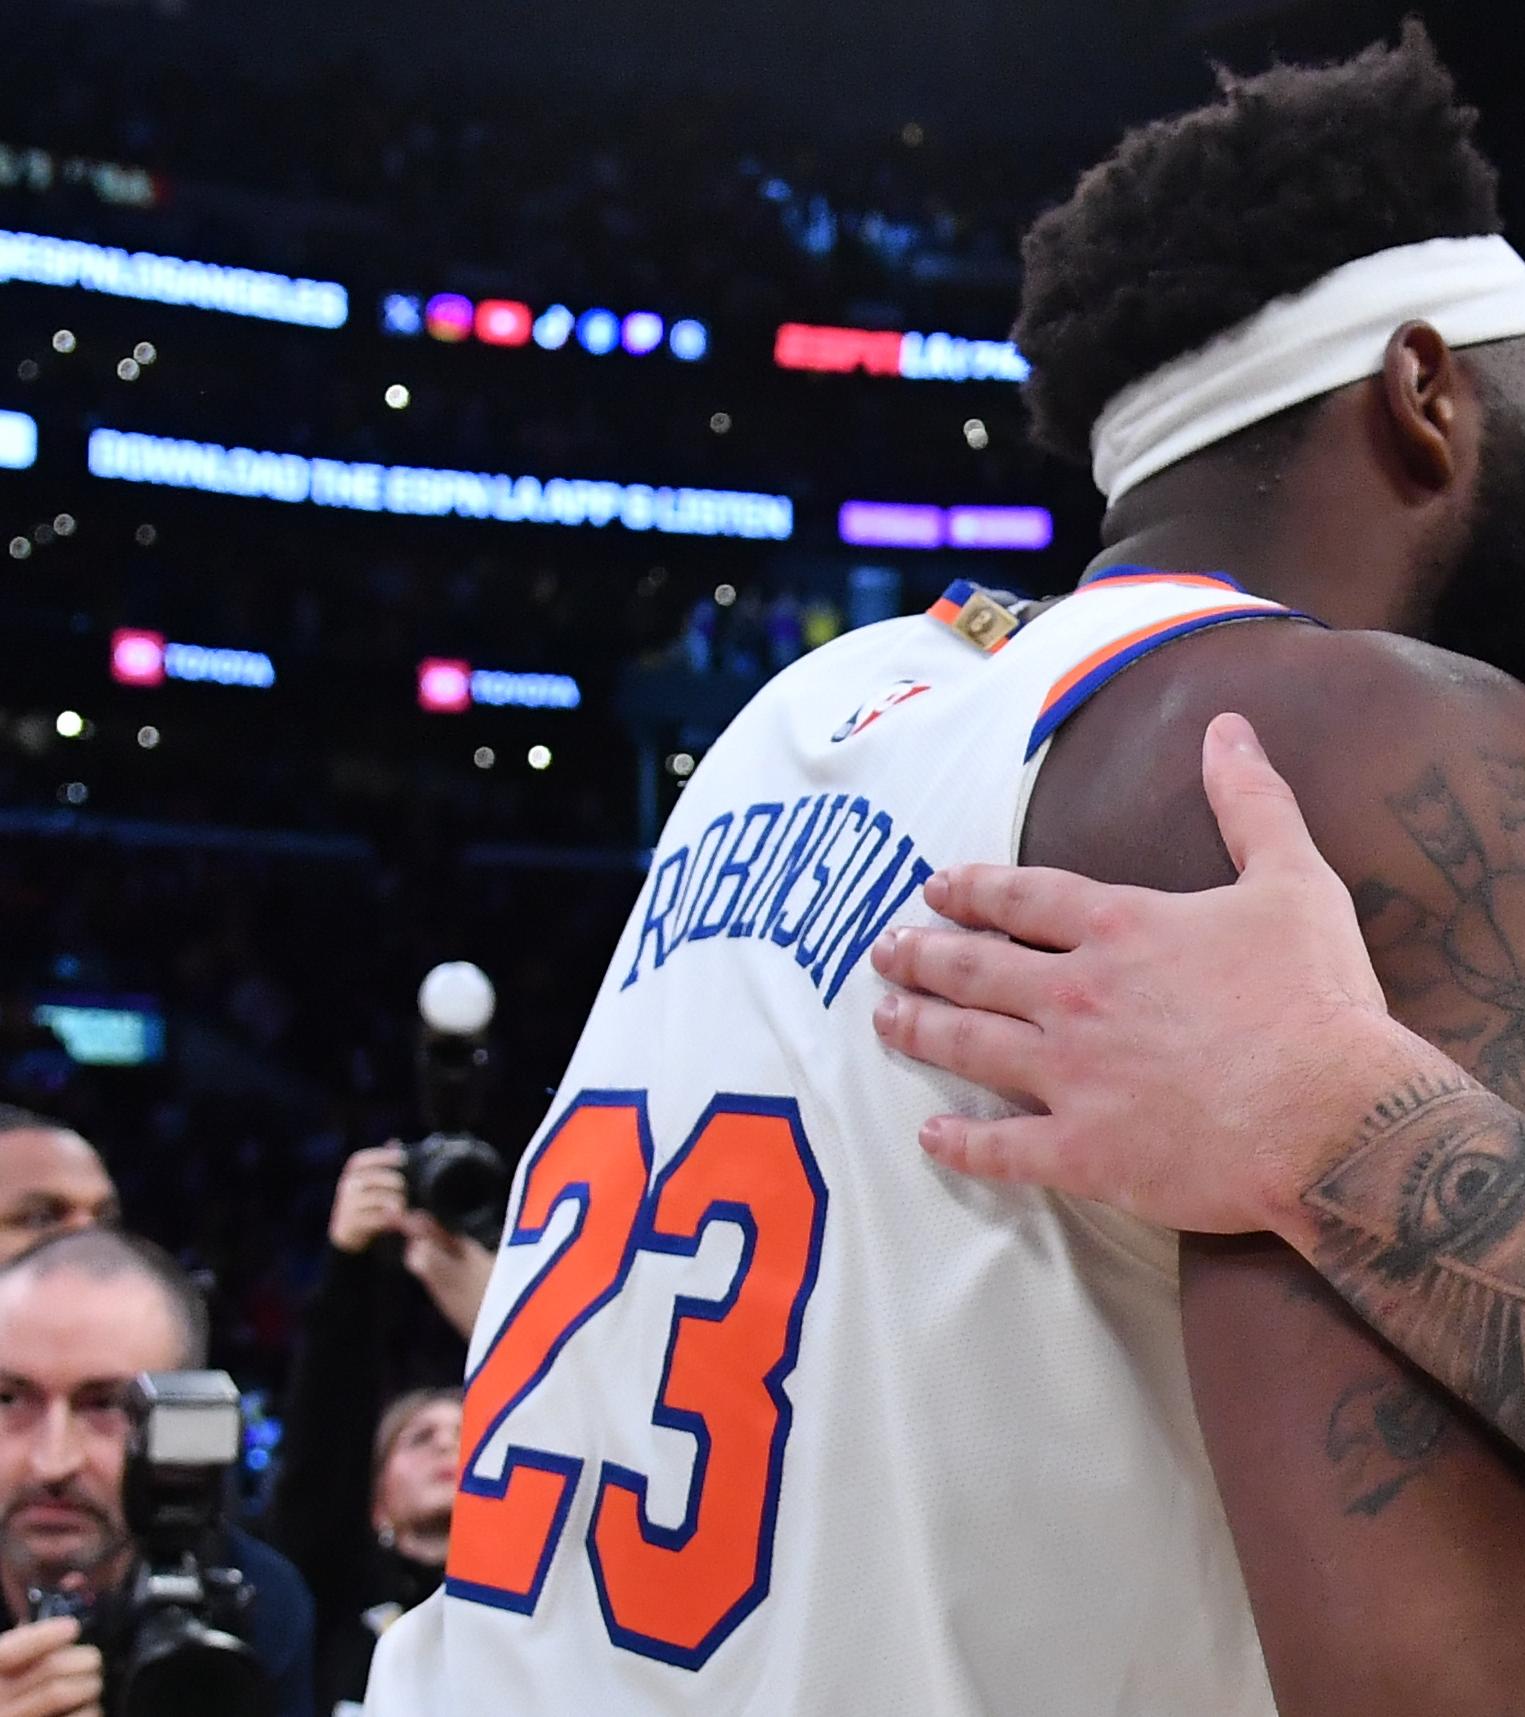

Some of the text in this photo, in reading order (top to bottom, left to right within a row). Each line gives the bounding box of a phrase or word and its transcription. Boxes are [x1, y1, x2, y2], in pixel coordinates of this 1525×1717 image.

[88, 428, 310, 502] DOWNLOAD
[311, 457, 382, 511] THE
[655, 486, 793, 541] LISTEN
[620, 794, 935, 1010] ROBINSON
[445, 1088, 829, 1672] 23
